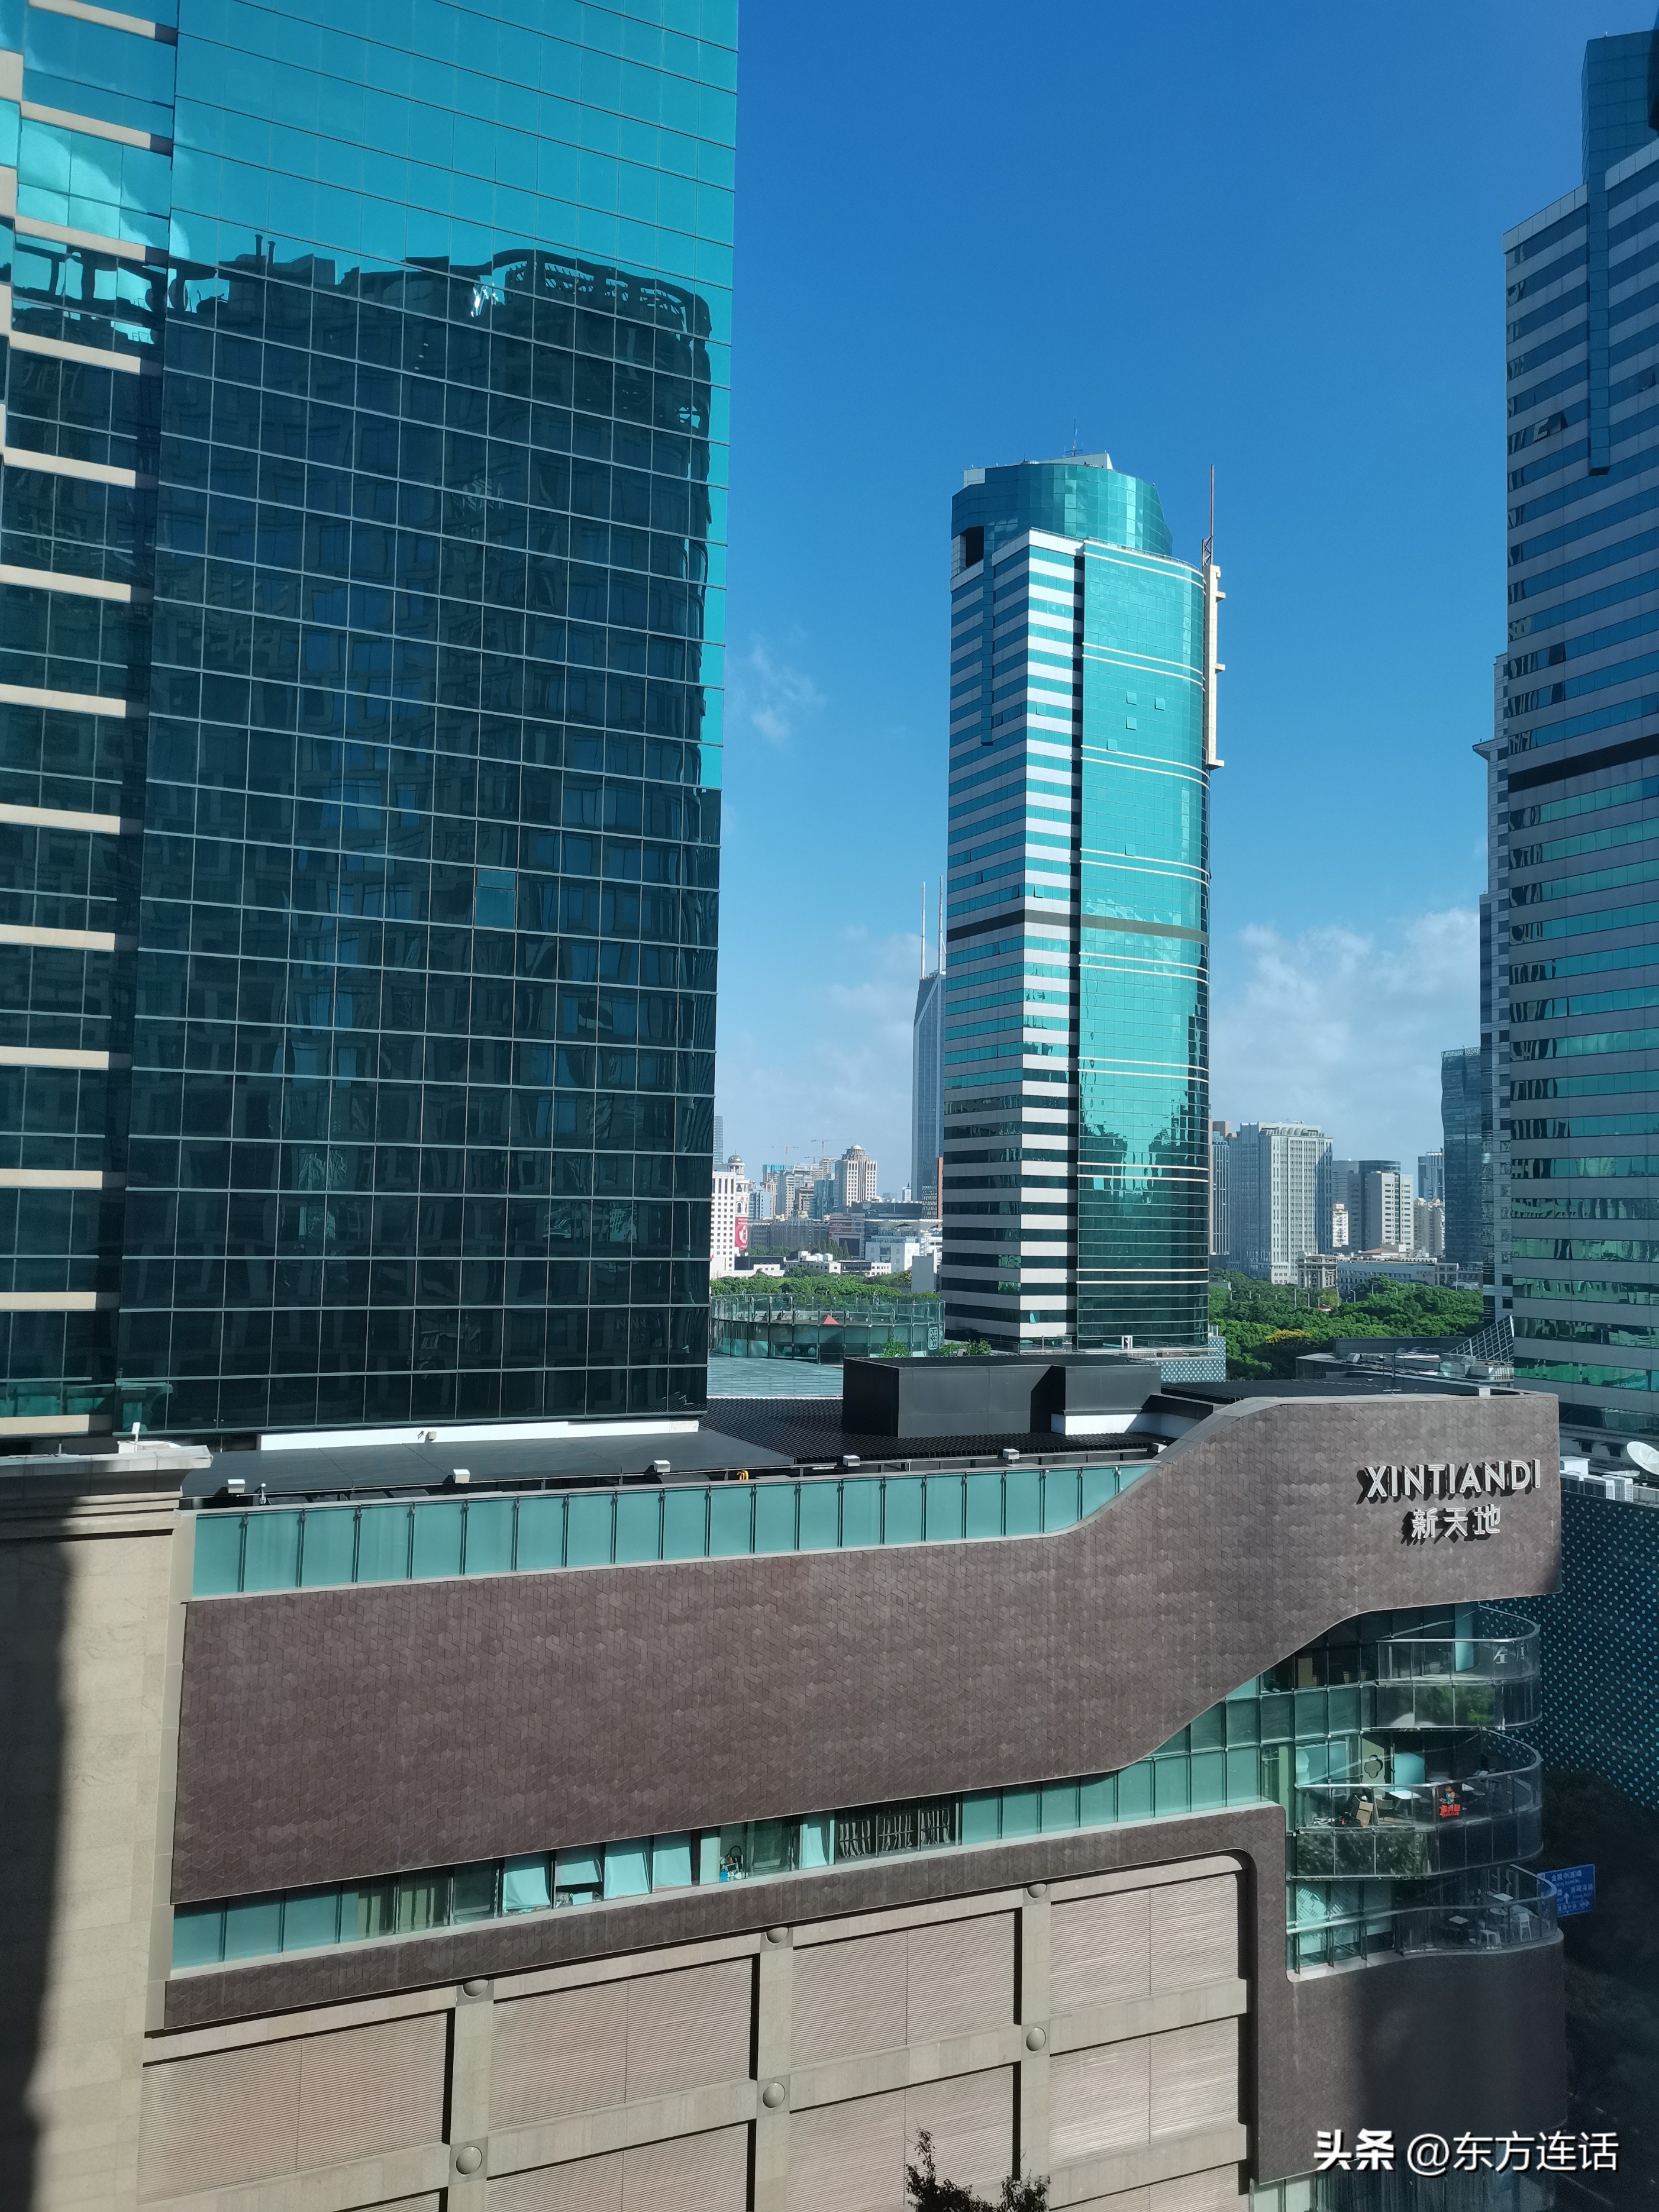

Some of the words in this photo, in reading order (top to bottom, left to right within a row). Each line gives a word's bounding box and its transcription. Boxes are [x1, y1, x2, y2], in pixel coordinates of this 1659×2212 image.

[1364, 1458, 1541, 1498] XINTIANDI
[1411, 1503, 1500, 1539] 新天地
